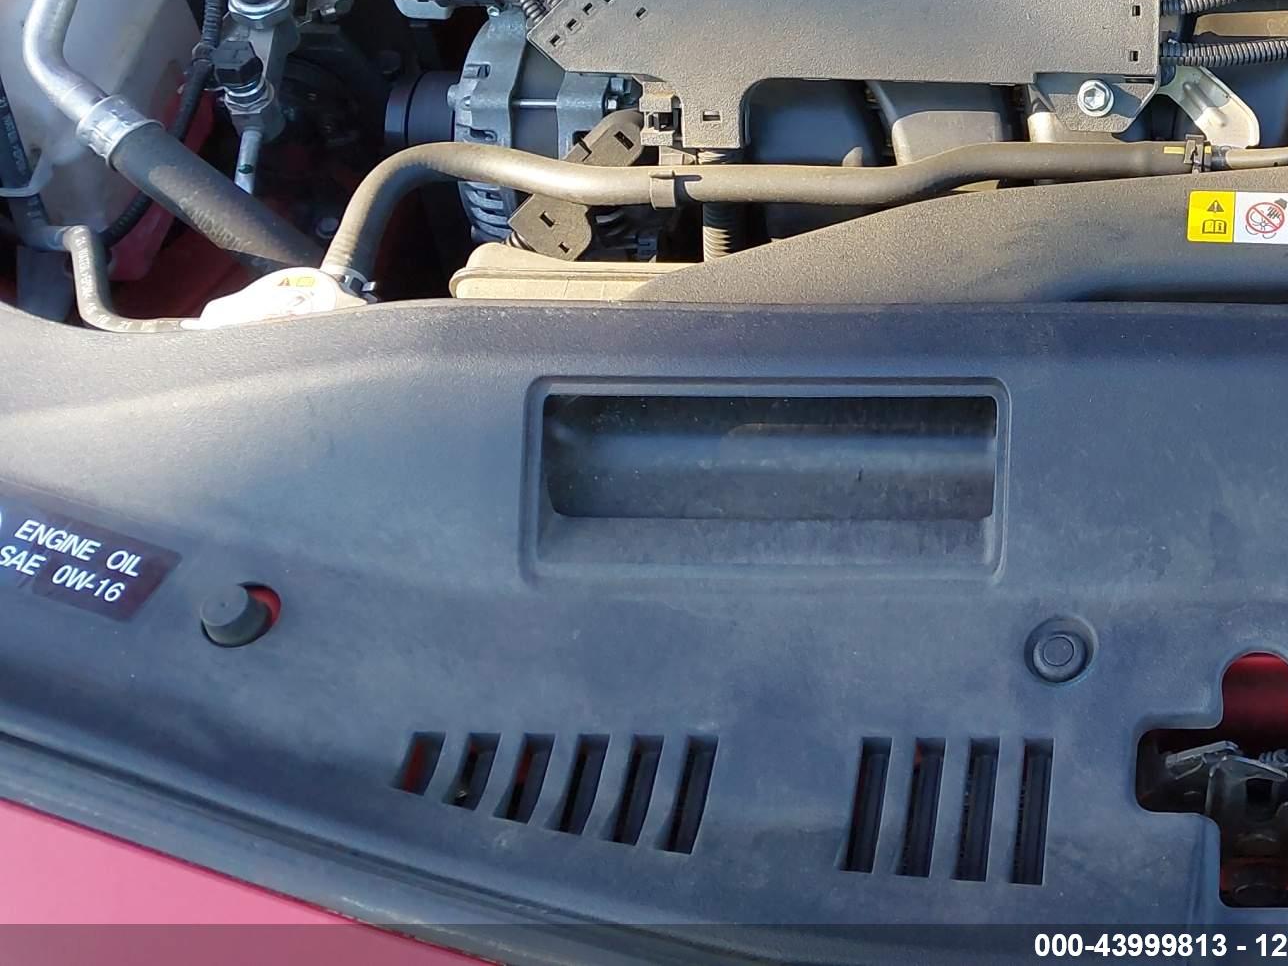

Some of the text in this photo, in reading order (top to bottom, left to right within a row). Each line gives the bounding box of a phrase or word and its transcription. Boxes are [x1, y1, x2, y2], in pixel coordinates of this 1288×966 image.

[0, 545, 126, 602] SAE 0W-16
[14, 519, 142, 577] ENGINE OIL
